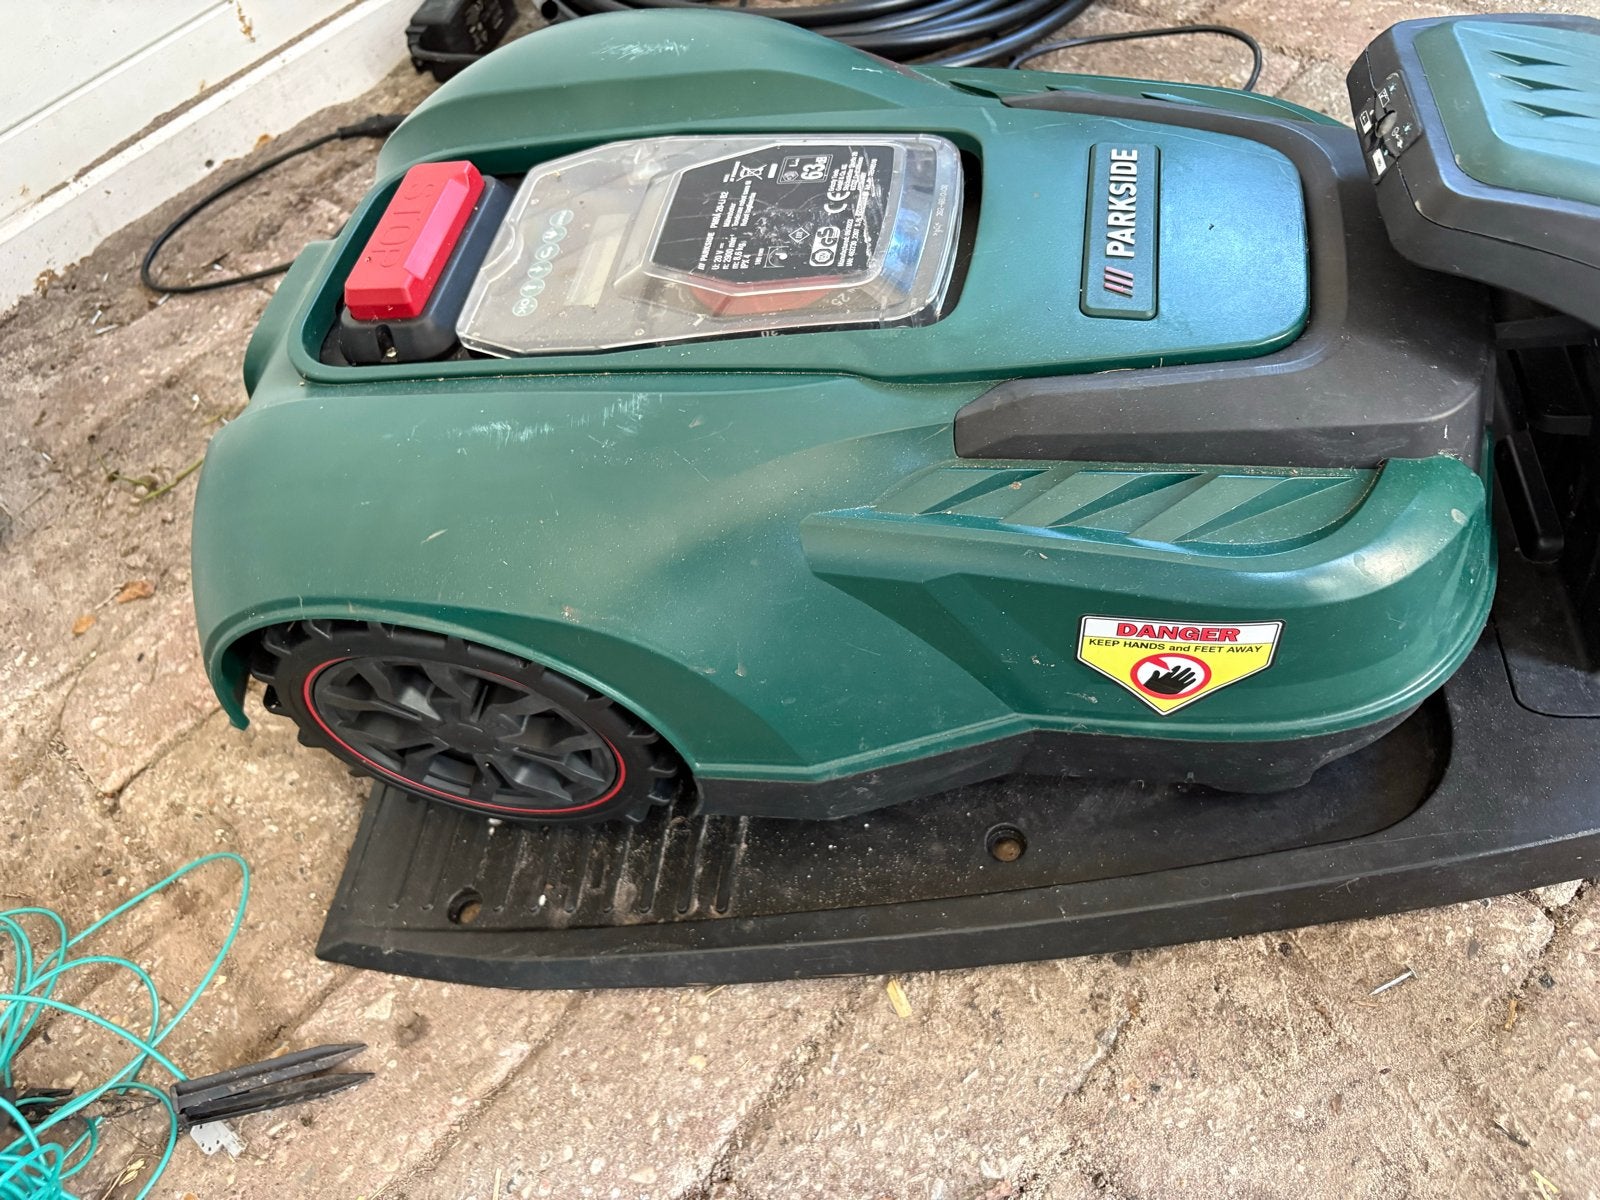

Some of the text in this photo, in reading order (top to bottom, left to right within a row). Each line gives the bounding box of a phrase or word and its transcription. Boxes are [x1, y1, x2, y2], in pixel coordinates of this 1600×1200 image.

[1105, 149, 1137, 258] PARKSIDE
[371, 183, 434, 268] STOP
[700, 232, 715, 261] PARKSIDE
[713, 255, 723, 263] 20
[723, 249, 734, 263] 2900
[516, 299, 530, 314] OK
[1116, 622, 1241, 642] DANGER
[1089, 638, 1263, 653] KEEP HANDS and FEET AWAY
